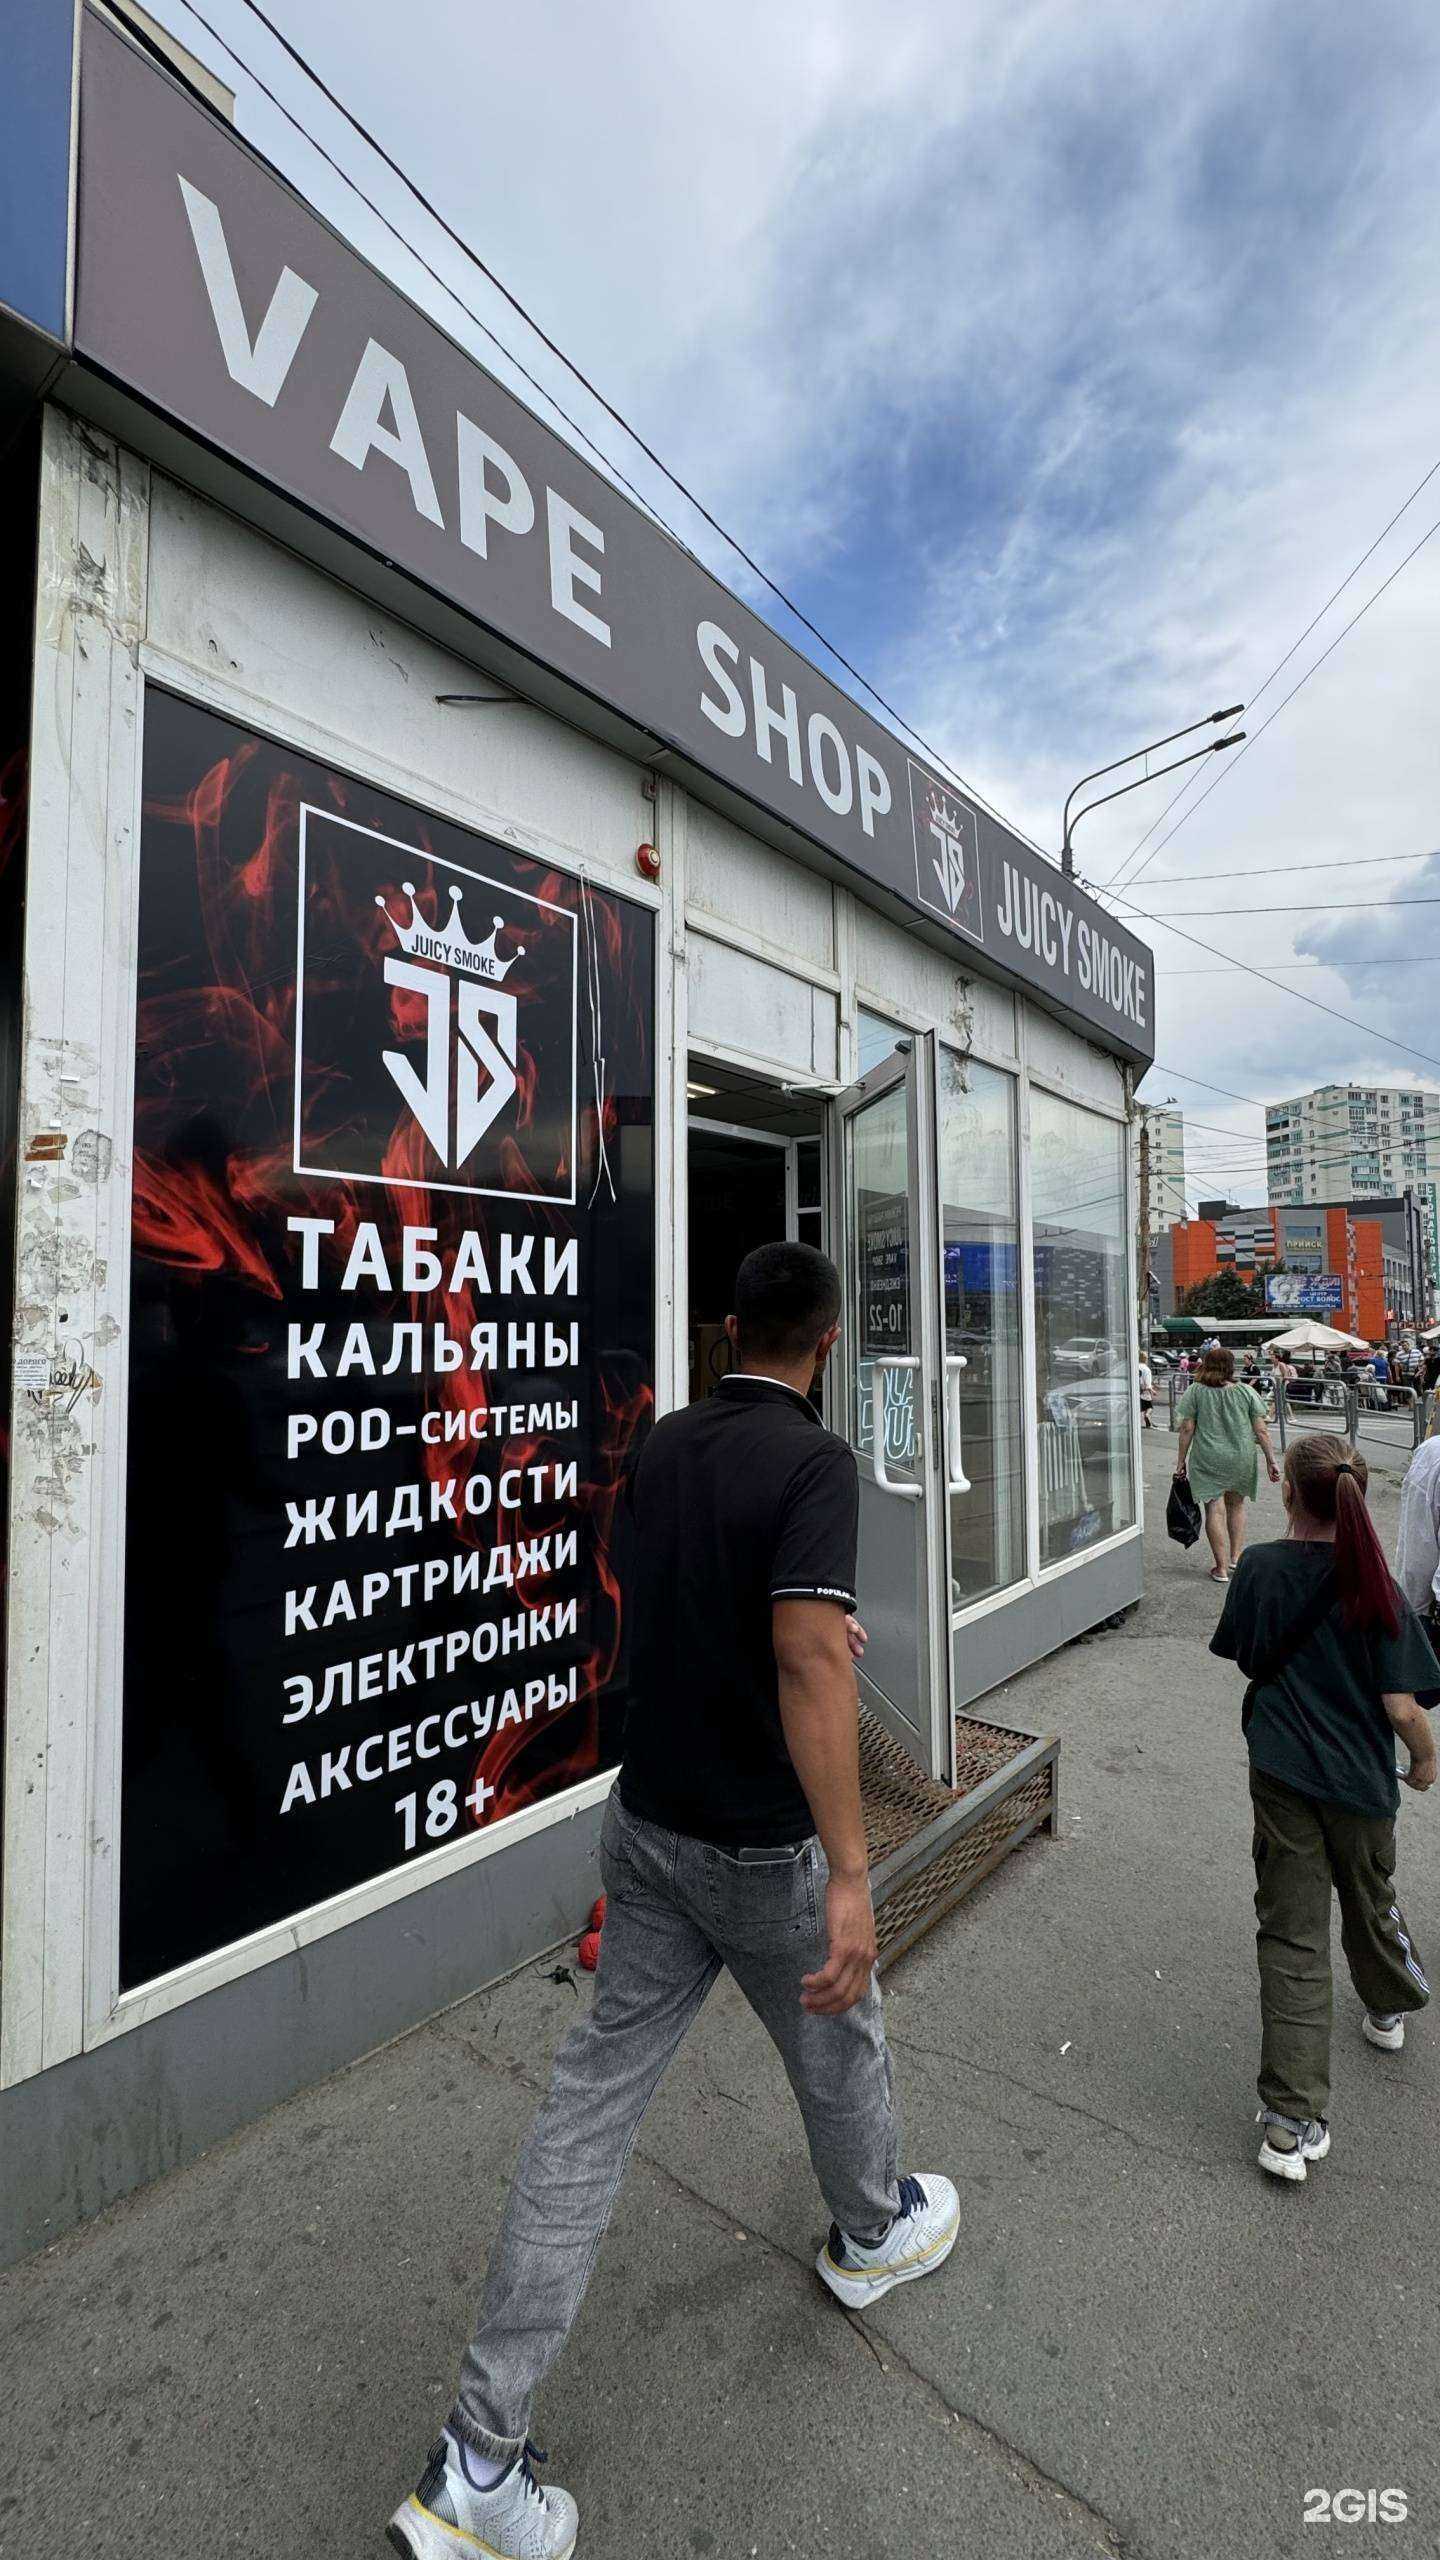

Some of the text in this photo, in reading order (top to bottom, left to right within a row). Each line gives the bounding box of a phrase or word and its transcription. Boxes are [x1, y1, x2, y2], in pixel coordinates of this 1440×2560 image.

[177, 173, 892, 838] VAPE SHOP
[411, 934, 496, 976] JUICY SMOKE
[997, 860, 1146, 1029] JUICY SMOKE
[286, 1216, 579, 1296] ТАБАКИ
[1286, 1240, 1322, 1249] ПРИИСК
[287, 1321, 580, 1379] КАЛЬЯНЫ
[283, 1461, 578, 1549] ЖИДКОСТИ
[284, 1530, 578, 1637] КАРТРИДЖИ
[281, 1598, 578, 1725] ЭЛЕКТРОНКИ
[279, 1666, 578, 1815] АКСЕССУАРЫ
[394, 1776, 495, 1851] 18+
